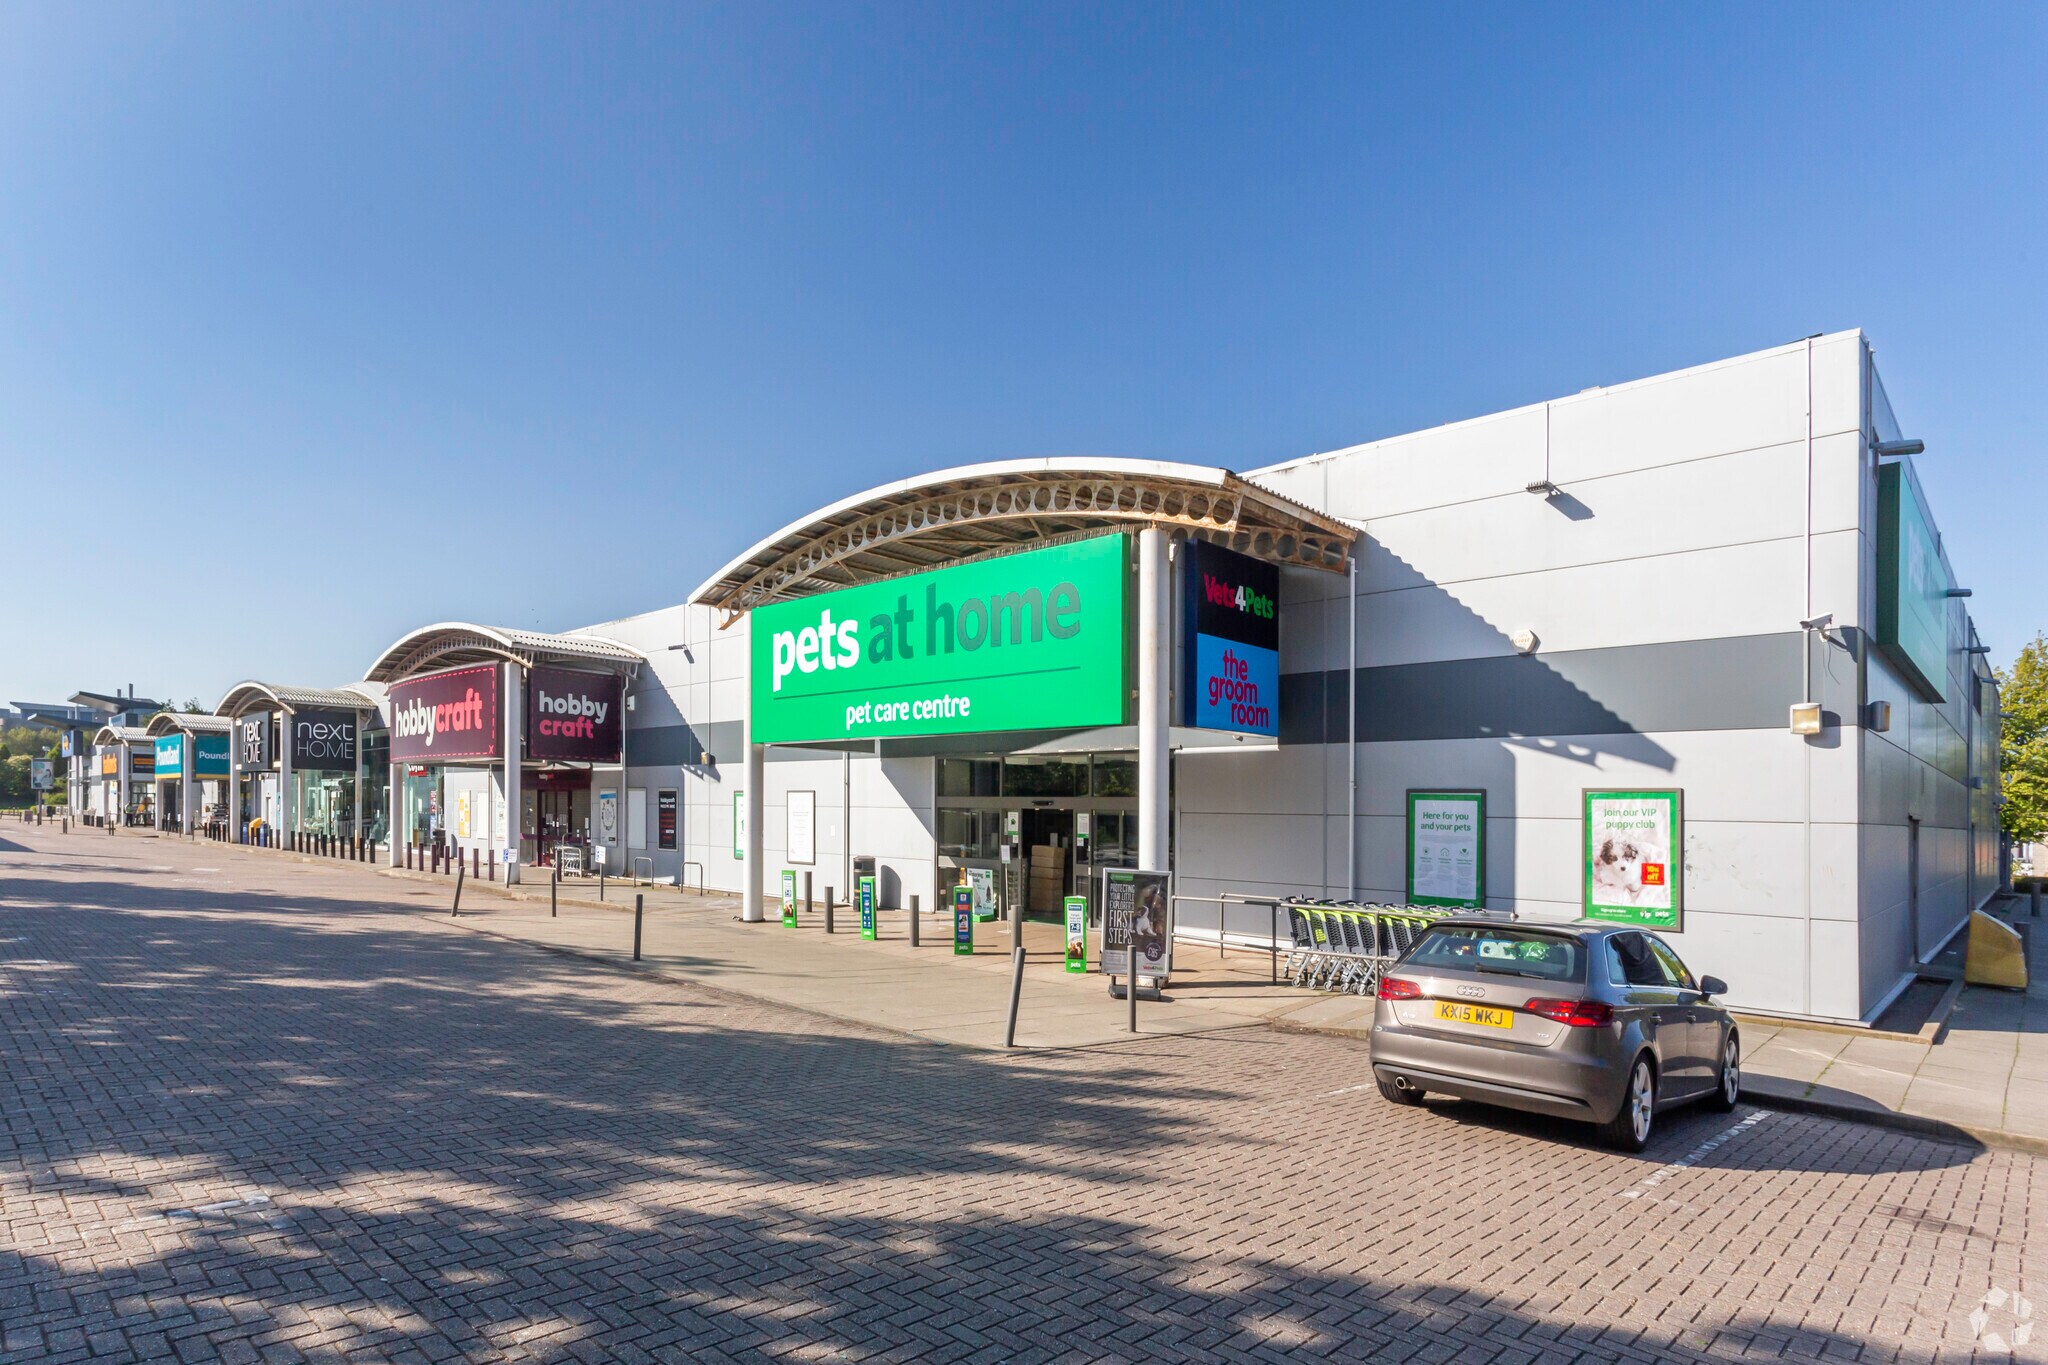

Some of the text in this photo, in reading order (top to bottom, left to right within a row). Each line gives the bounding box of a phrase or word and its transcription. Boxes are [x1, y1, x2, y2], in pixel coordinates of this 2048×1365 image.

[1202, 573, 1274, 620] Vets4Pets
[772, 581, 1081, 692] pets at home
[1223, 649, 1249, 680] the
[1208, 676, 1259, 706] groom
[395, 687, 483, 747] hobbycraft
[538, 690, 608, 725] hobby
[845, 694, 971, 730] pet care centre
[1230, 698, 1270, 728] room
[243, 719, 261, 742] next
[296, 721, 354, 741] next
[539, 715, 595, 740] craft
[243, 742, 261, 763] HOME
[296, 739, 354, 760] HOME
[1422, 811, 1470, 822] Here for you
[1603, 808, 1657, 818] Join our VIP
[1420, 822, 1472, 833] and your pets
[1605, 820, 1656, 831] puppy club
[1646, 873, 1660, 881] off
[1121, 892, 1135, 902] LITTLE
[1108, 910, 1135, 928] FIRST
[1147, 947, 1159, 958] £85
[1440, 1004, 1504, 1026] KX15 WKJ
